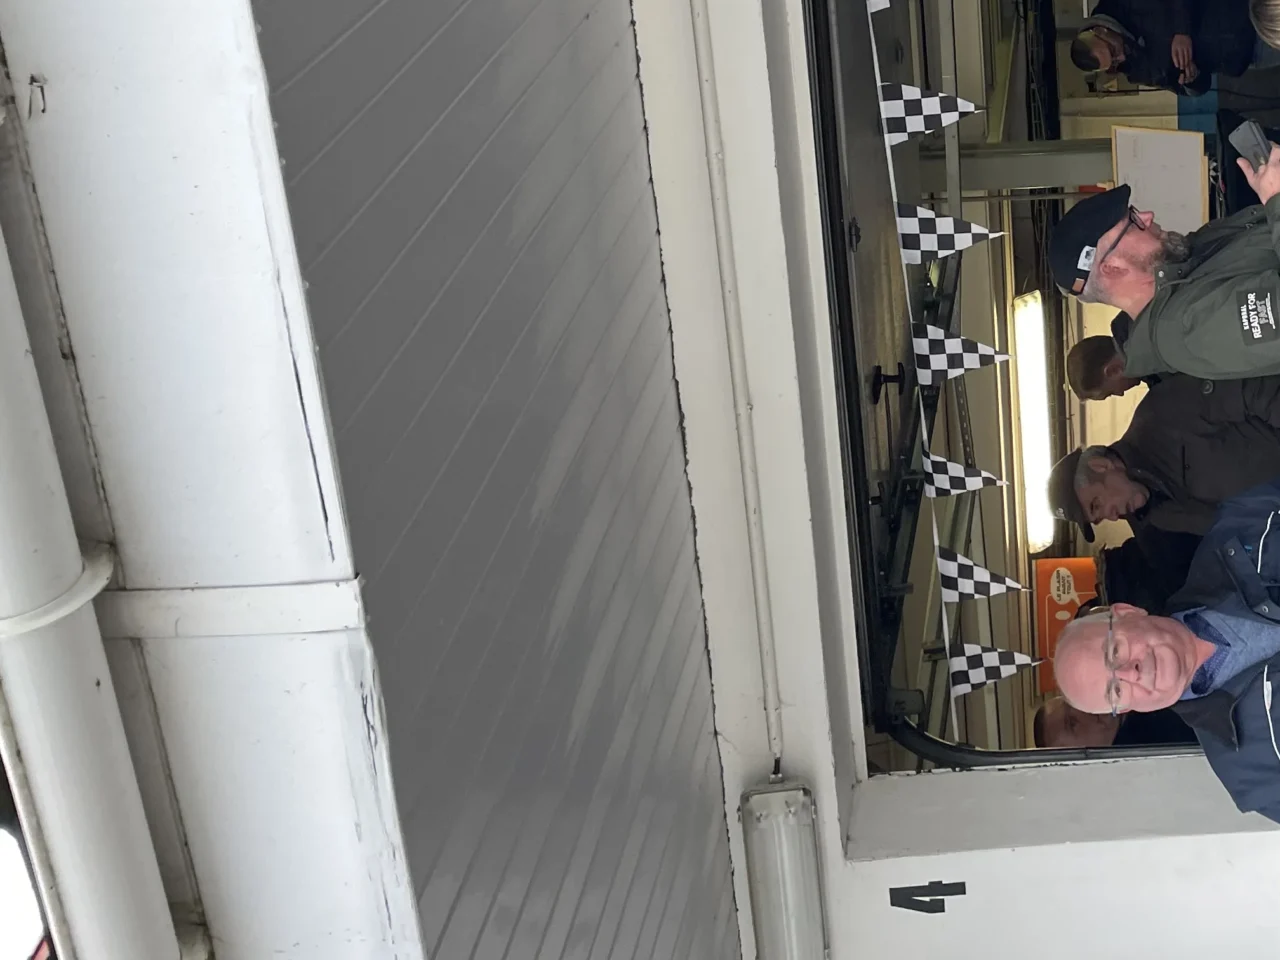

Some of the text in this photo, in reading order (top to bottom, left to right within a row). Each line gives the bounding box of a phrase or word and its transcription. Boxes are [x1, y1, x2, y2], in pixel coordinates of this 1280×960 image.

[1248, 292, 1262, 338] READY FOR
[1256, 300, 1268, 324] FAST
[889, 880, 966, 913] 4
